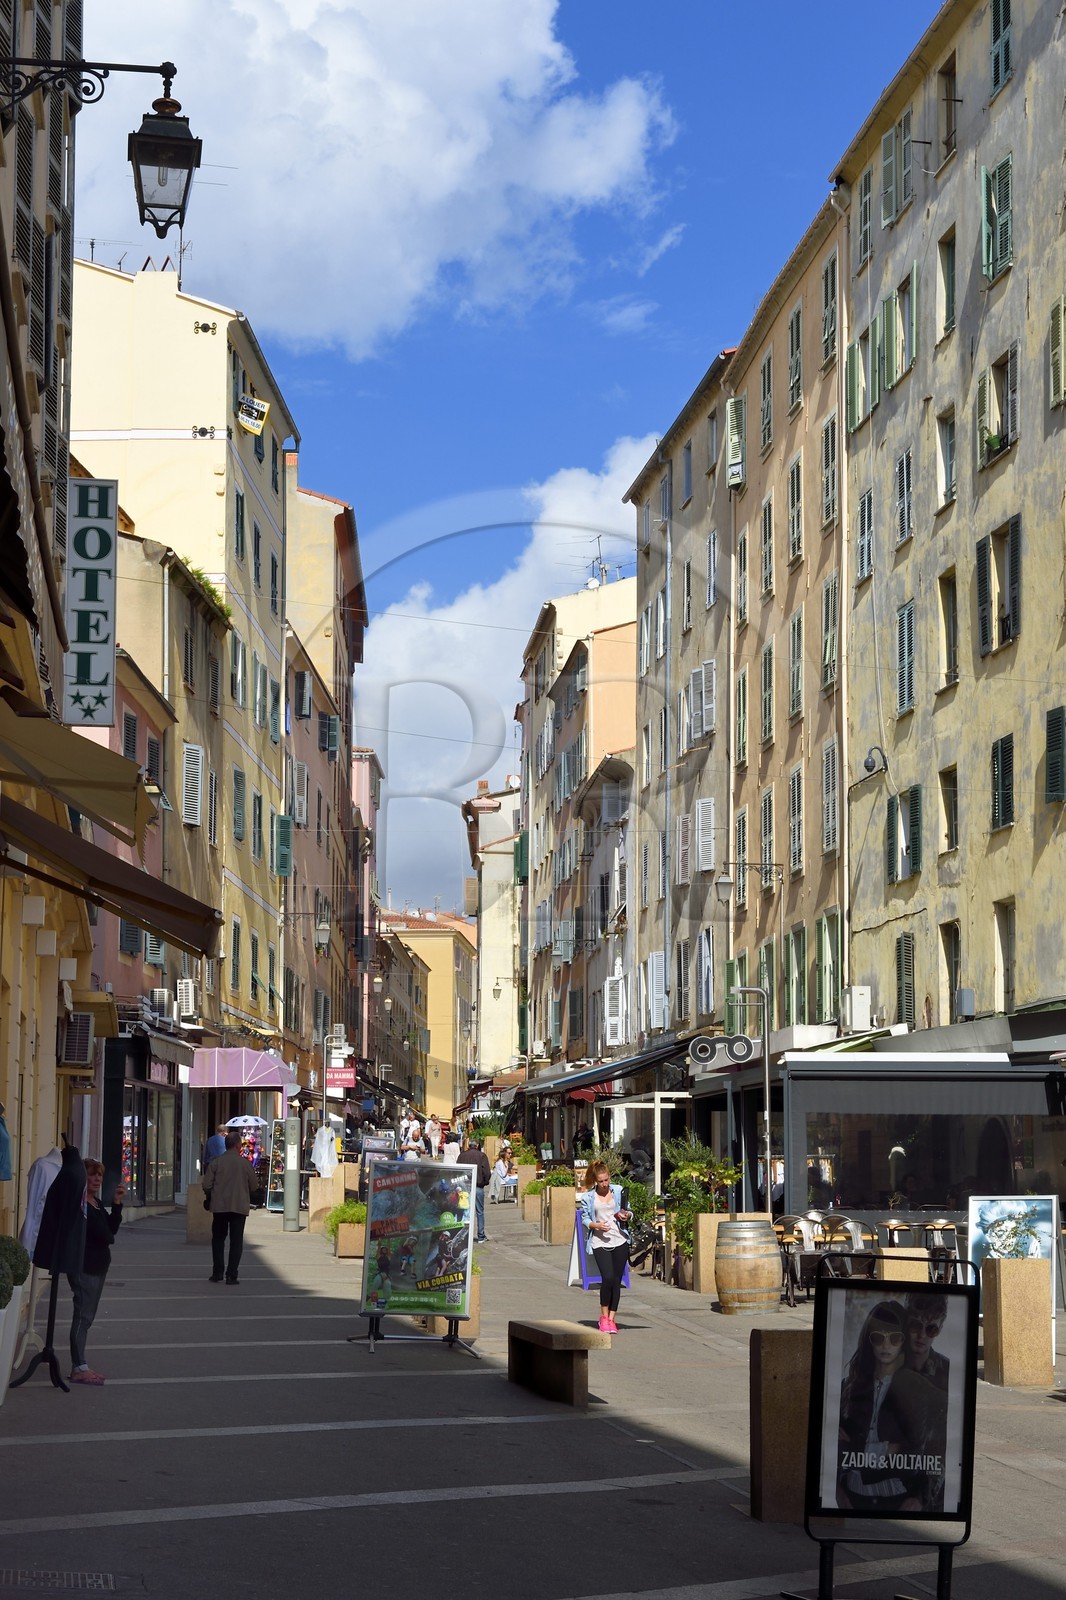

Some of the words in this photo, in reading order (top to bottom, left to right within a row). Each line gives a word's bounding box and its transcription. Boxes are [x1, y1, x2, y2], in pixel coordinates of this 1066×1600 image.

[246, 398, 266, 409] LOUER
[69, 484, 114, 687] HOTEL
[376, 1172, 417, 1188] CANYONING
[417, 1279, 430, 1289] VIA
[431, 1272, 464, 1286] CORDATA
